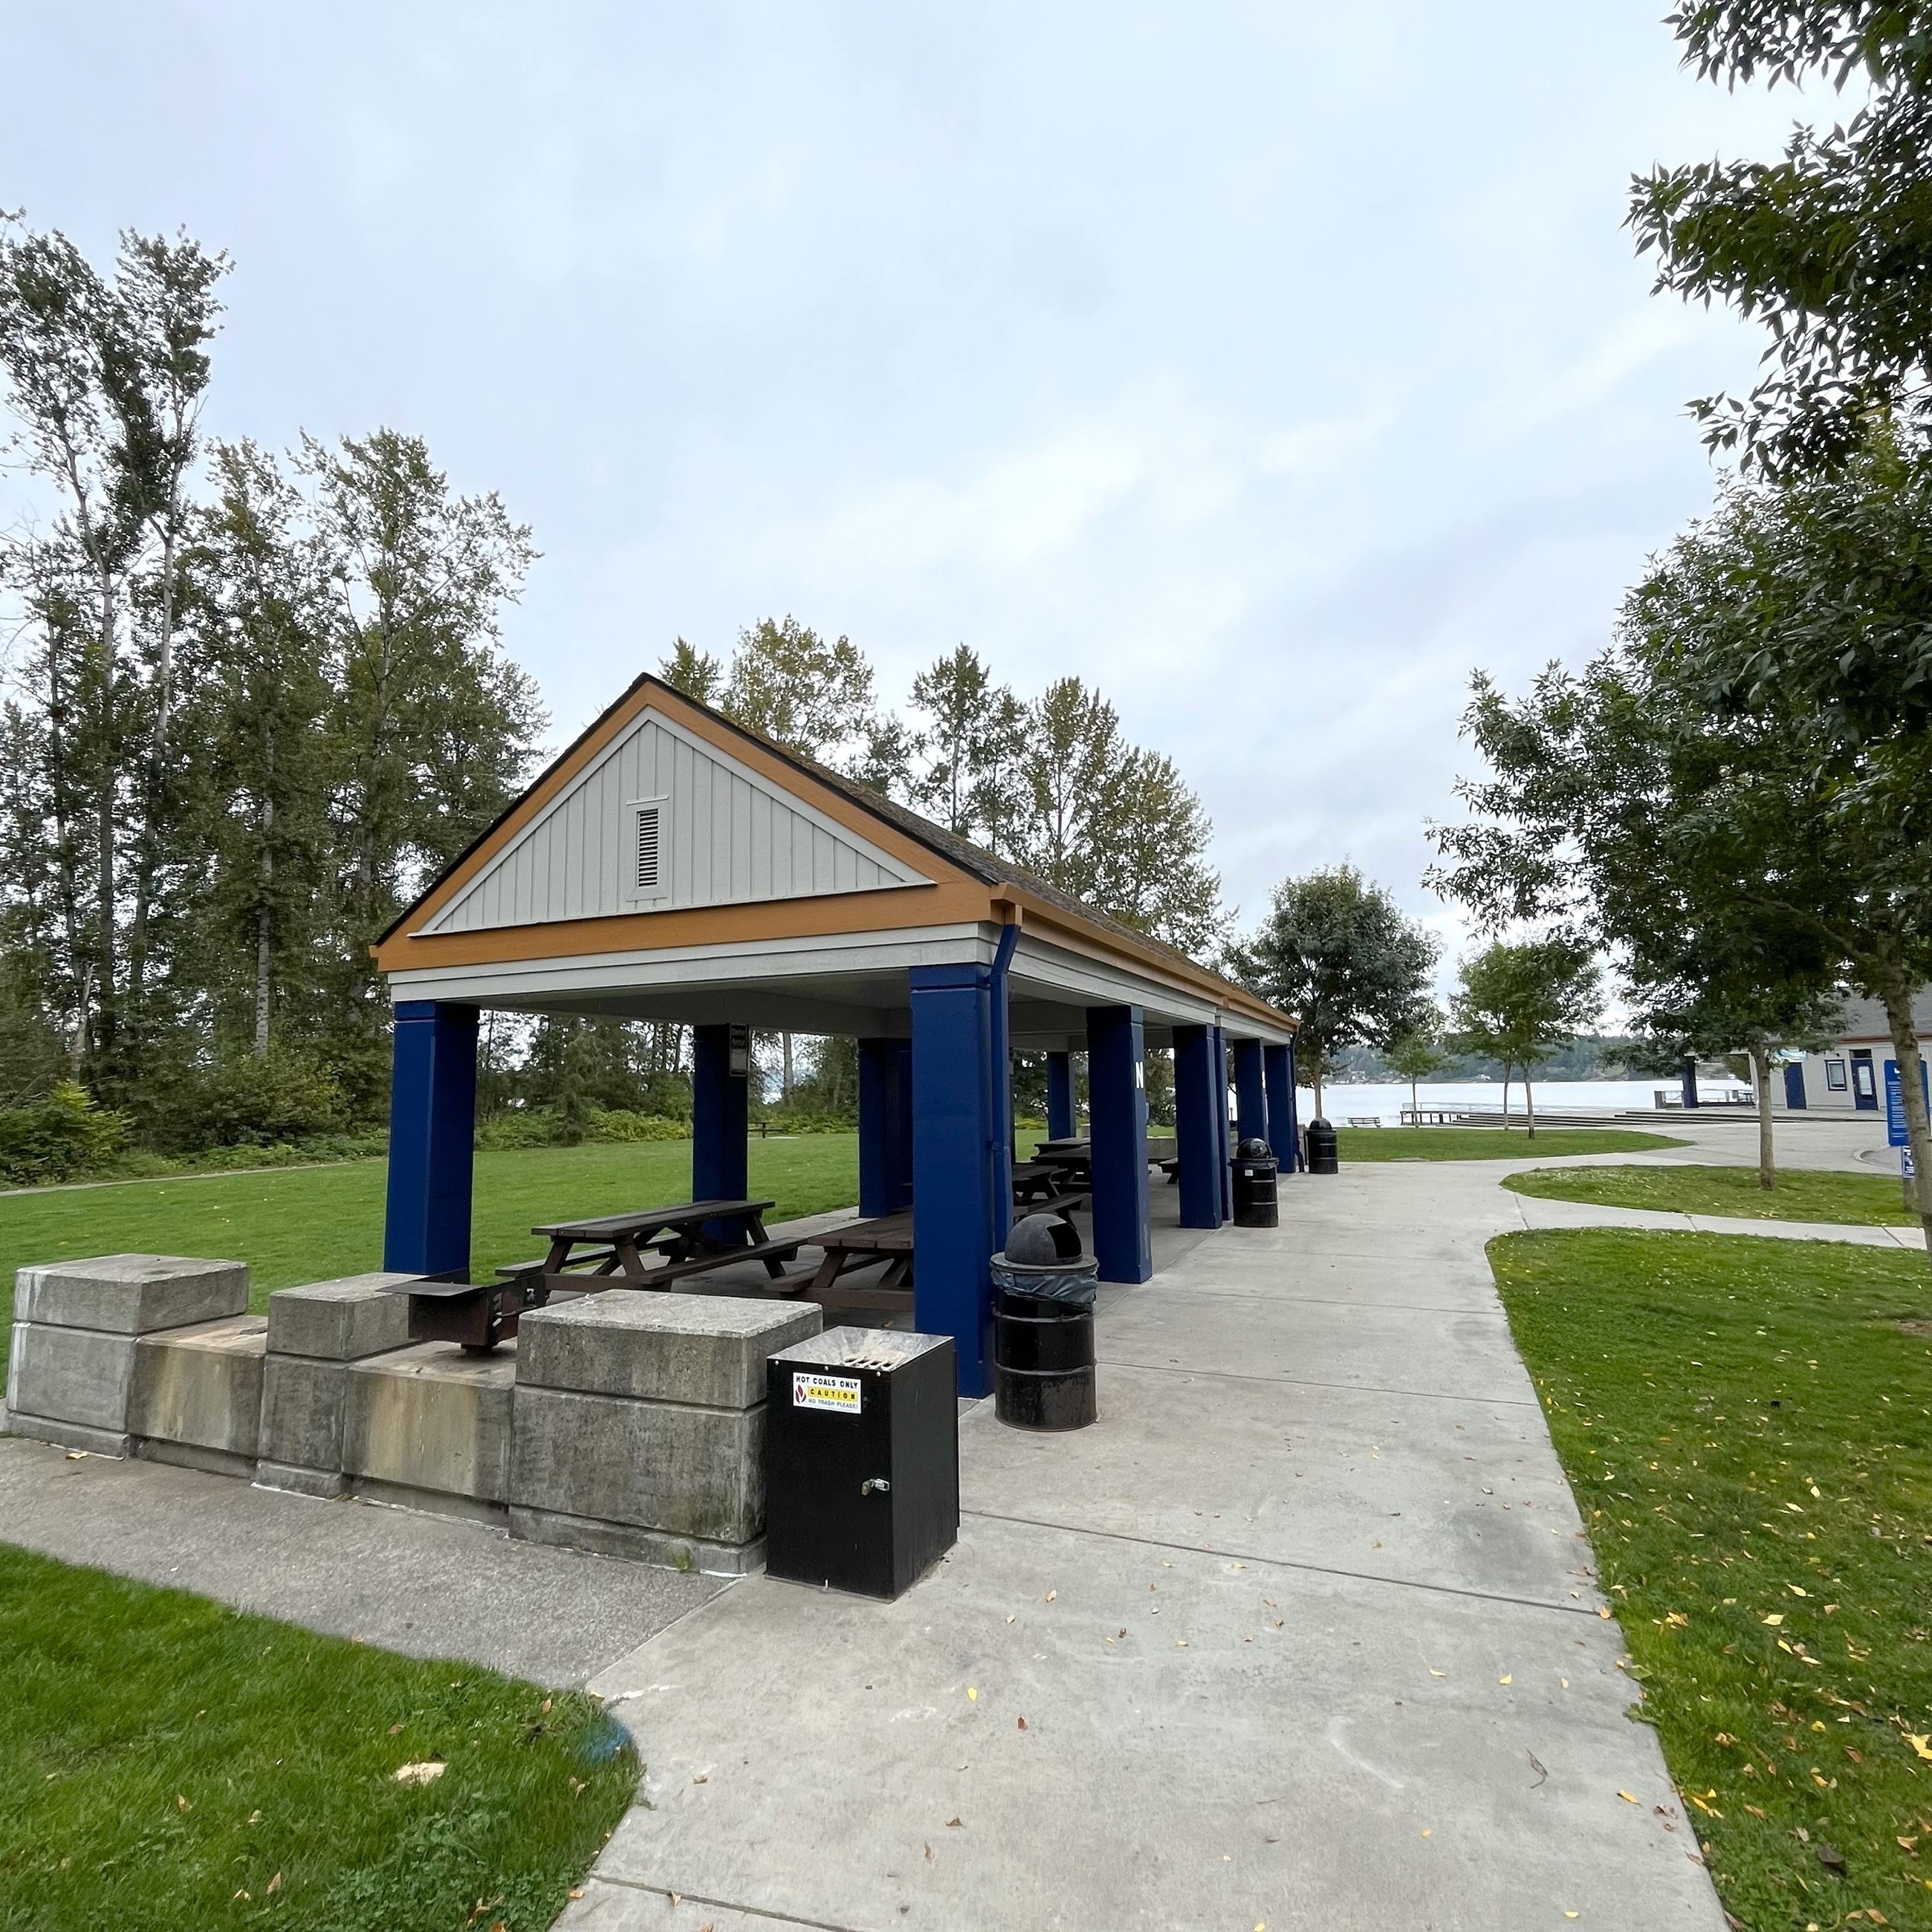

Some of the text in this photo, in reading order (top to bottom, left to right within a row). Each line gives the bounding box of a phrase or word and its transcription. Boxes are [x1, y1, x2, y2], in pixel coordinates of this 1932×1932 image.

[1135, 1061, 1144, 1089] N
[813, 1378, 836, 1387] COALS
[840, 1381, 858, 1389] ONLY
[810, 1388, 855, 1399] CAUTION
[837, 1401, 858, 1410] PLEASE!
